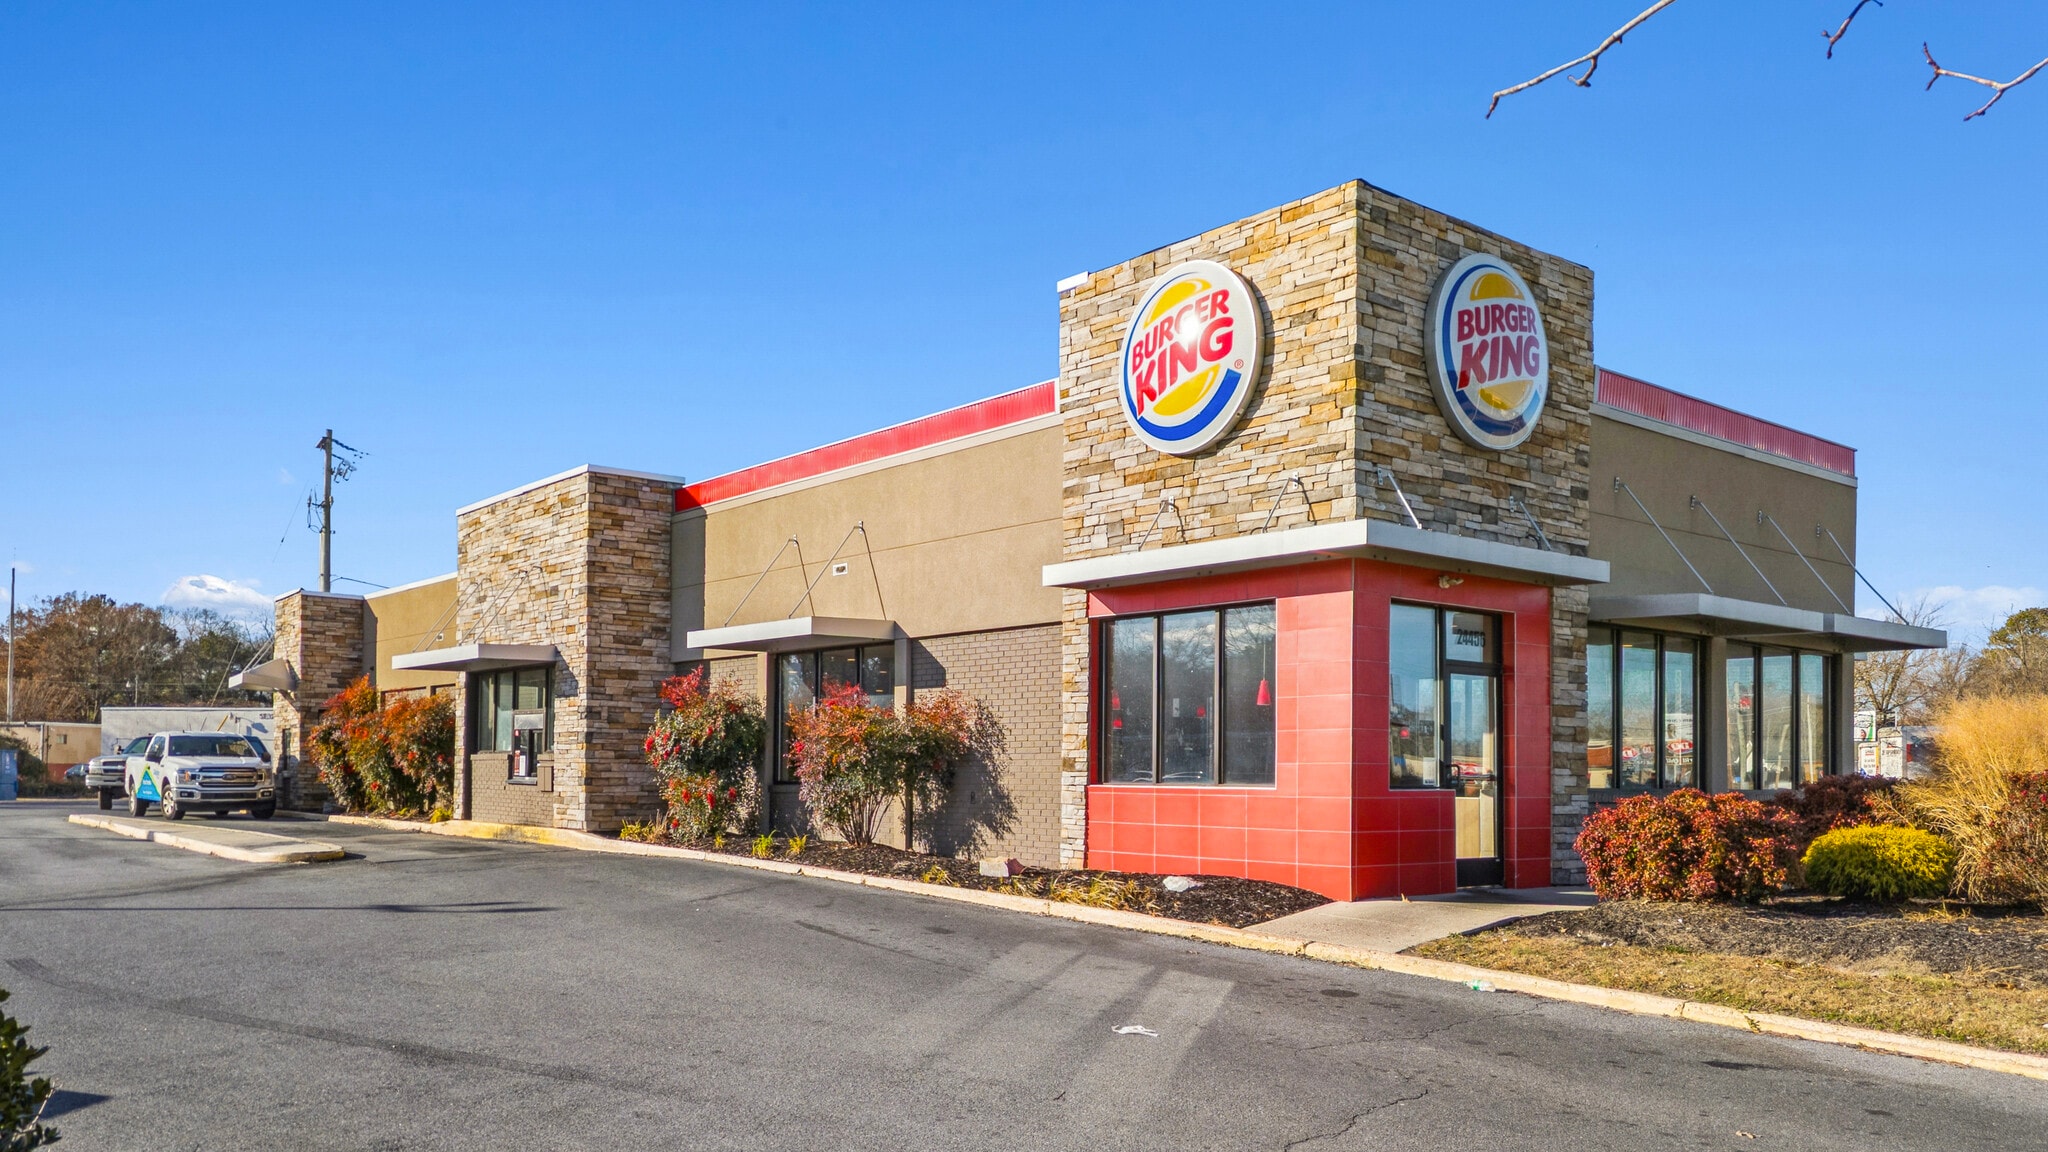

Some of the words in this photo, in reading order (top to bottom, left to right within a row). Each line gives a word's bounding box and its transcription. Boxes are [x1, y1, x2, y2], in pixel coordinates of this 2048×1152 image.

[1132, 289, 1230, 375] BURGER
[1457, 303, 1537, 342] BURGER
[1135, 316, 1234, 416] KING
[1457, 335, 1540, 390] KING
